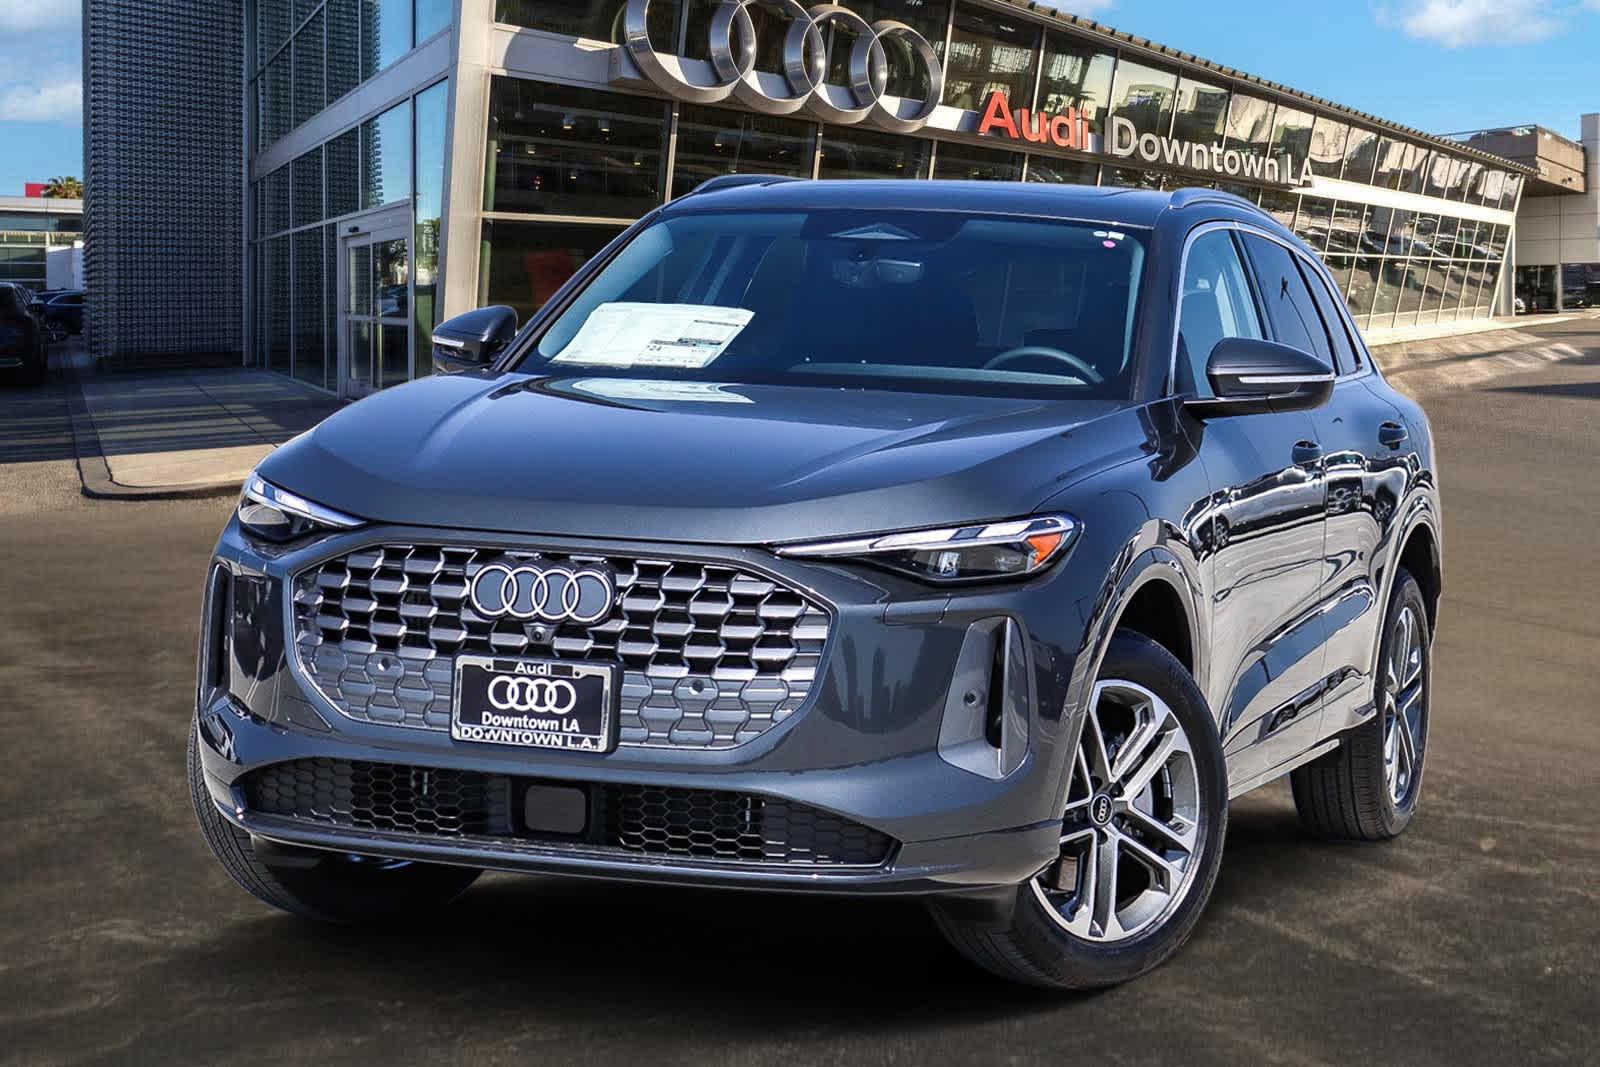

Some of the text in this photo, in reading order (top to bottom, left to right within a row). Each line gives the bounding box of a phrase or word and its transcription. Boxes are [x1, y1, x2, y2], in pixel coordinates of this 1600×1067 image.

[978, 90, 1314, 188] Audi Downtown LA
[514, 662, 552, 675] Audi
[481, 711, 580, 732] Downtown LA
[460, 727, 598, 749] DOWNTOWN L.A.
